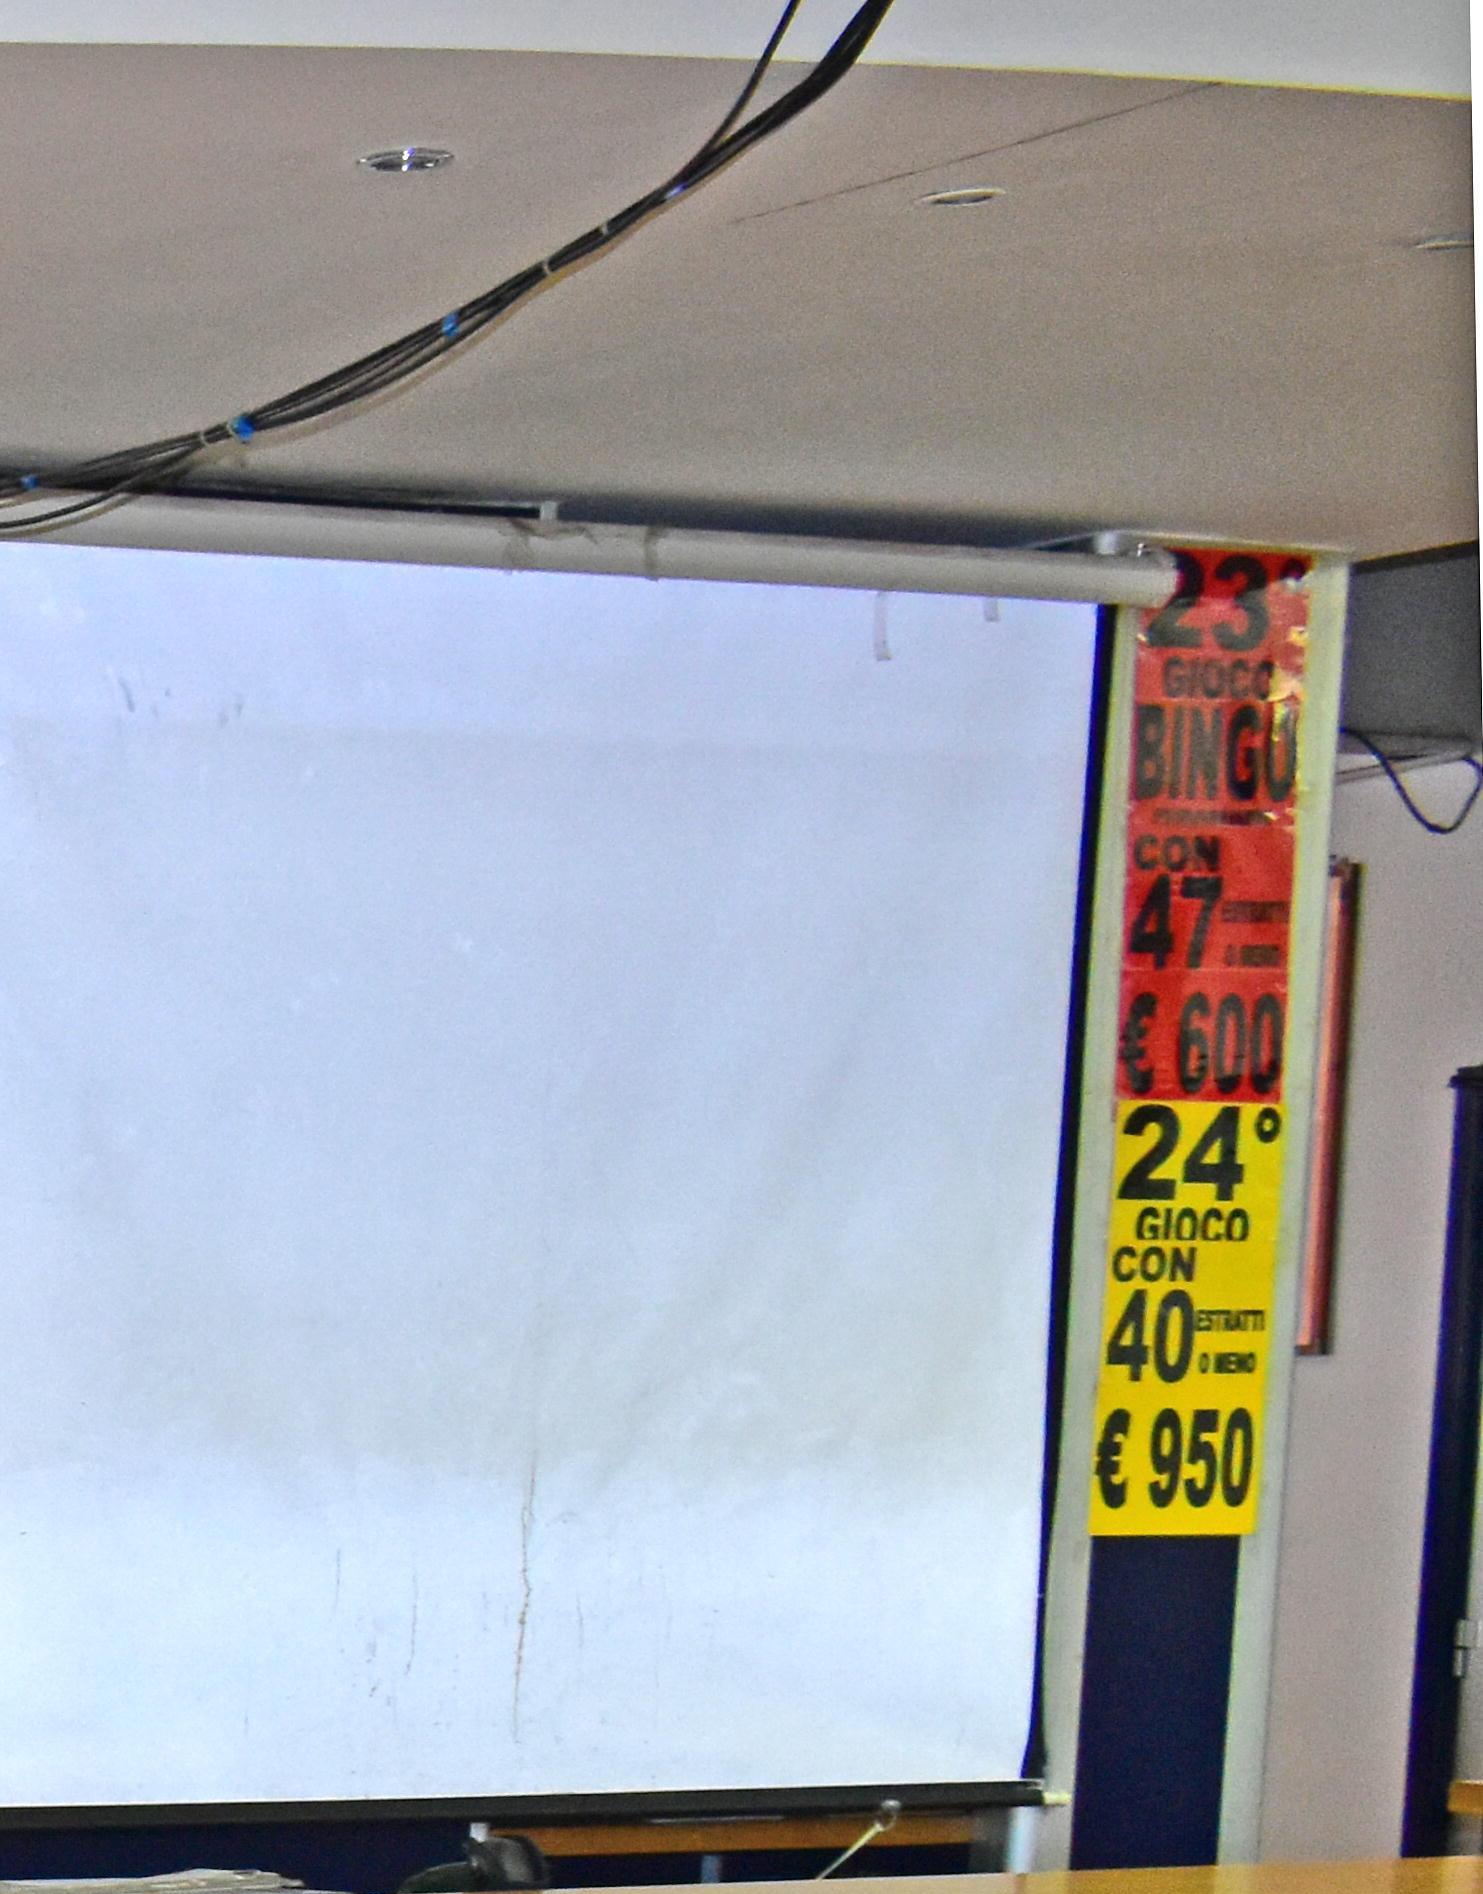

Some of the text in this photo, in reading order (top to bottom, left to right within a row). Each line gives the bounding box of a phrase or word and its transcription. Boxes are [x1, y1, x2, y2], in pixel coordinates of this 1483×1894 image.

[1134, 834, 1221, 872] CON
[1129, 874, 1223, 969] 47
[1119, 991, 1283, 1094] € 600
[1117, 1104, 1281, 1201] 24°
[1111, 1246, 1197, 1282] CON
[1136, 1206, 1251, 1242] GIOCO
[1106, 1289, 1267, 1383] 40 ESTRATTI
[1213, 1351, 1257, 1375] MENO
[1095, 1407, 1254, 1510] € 950
